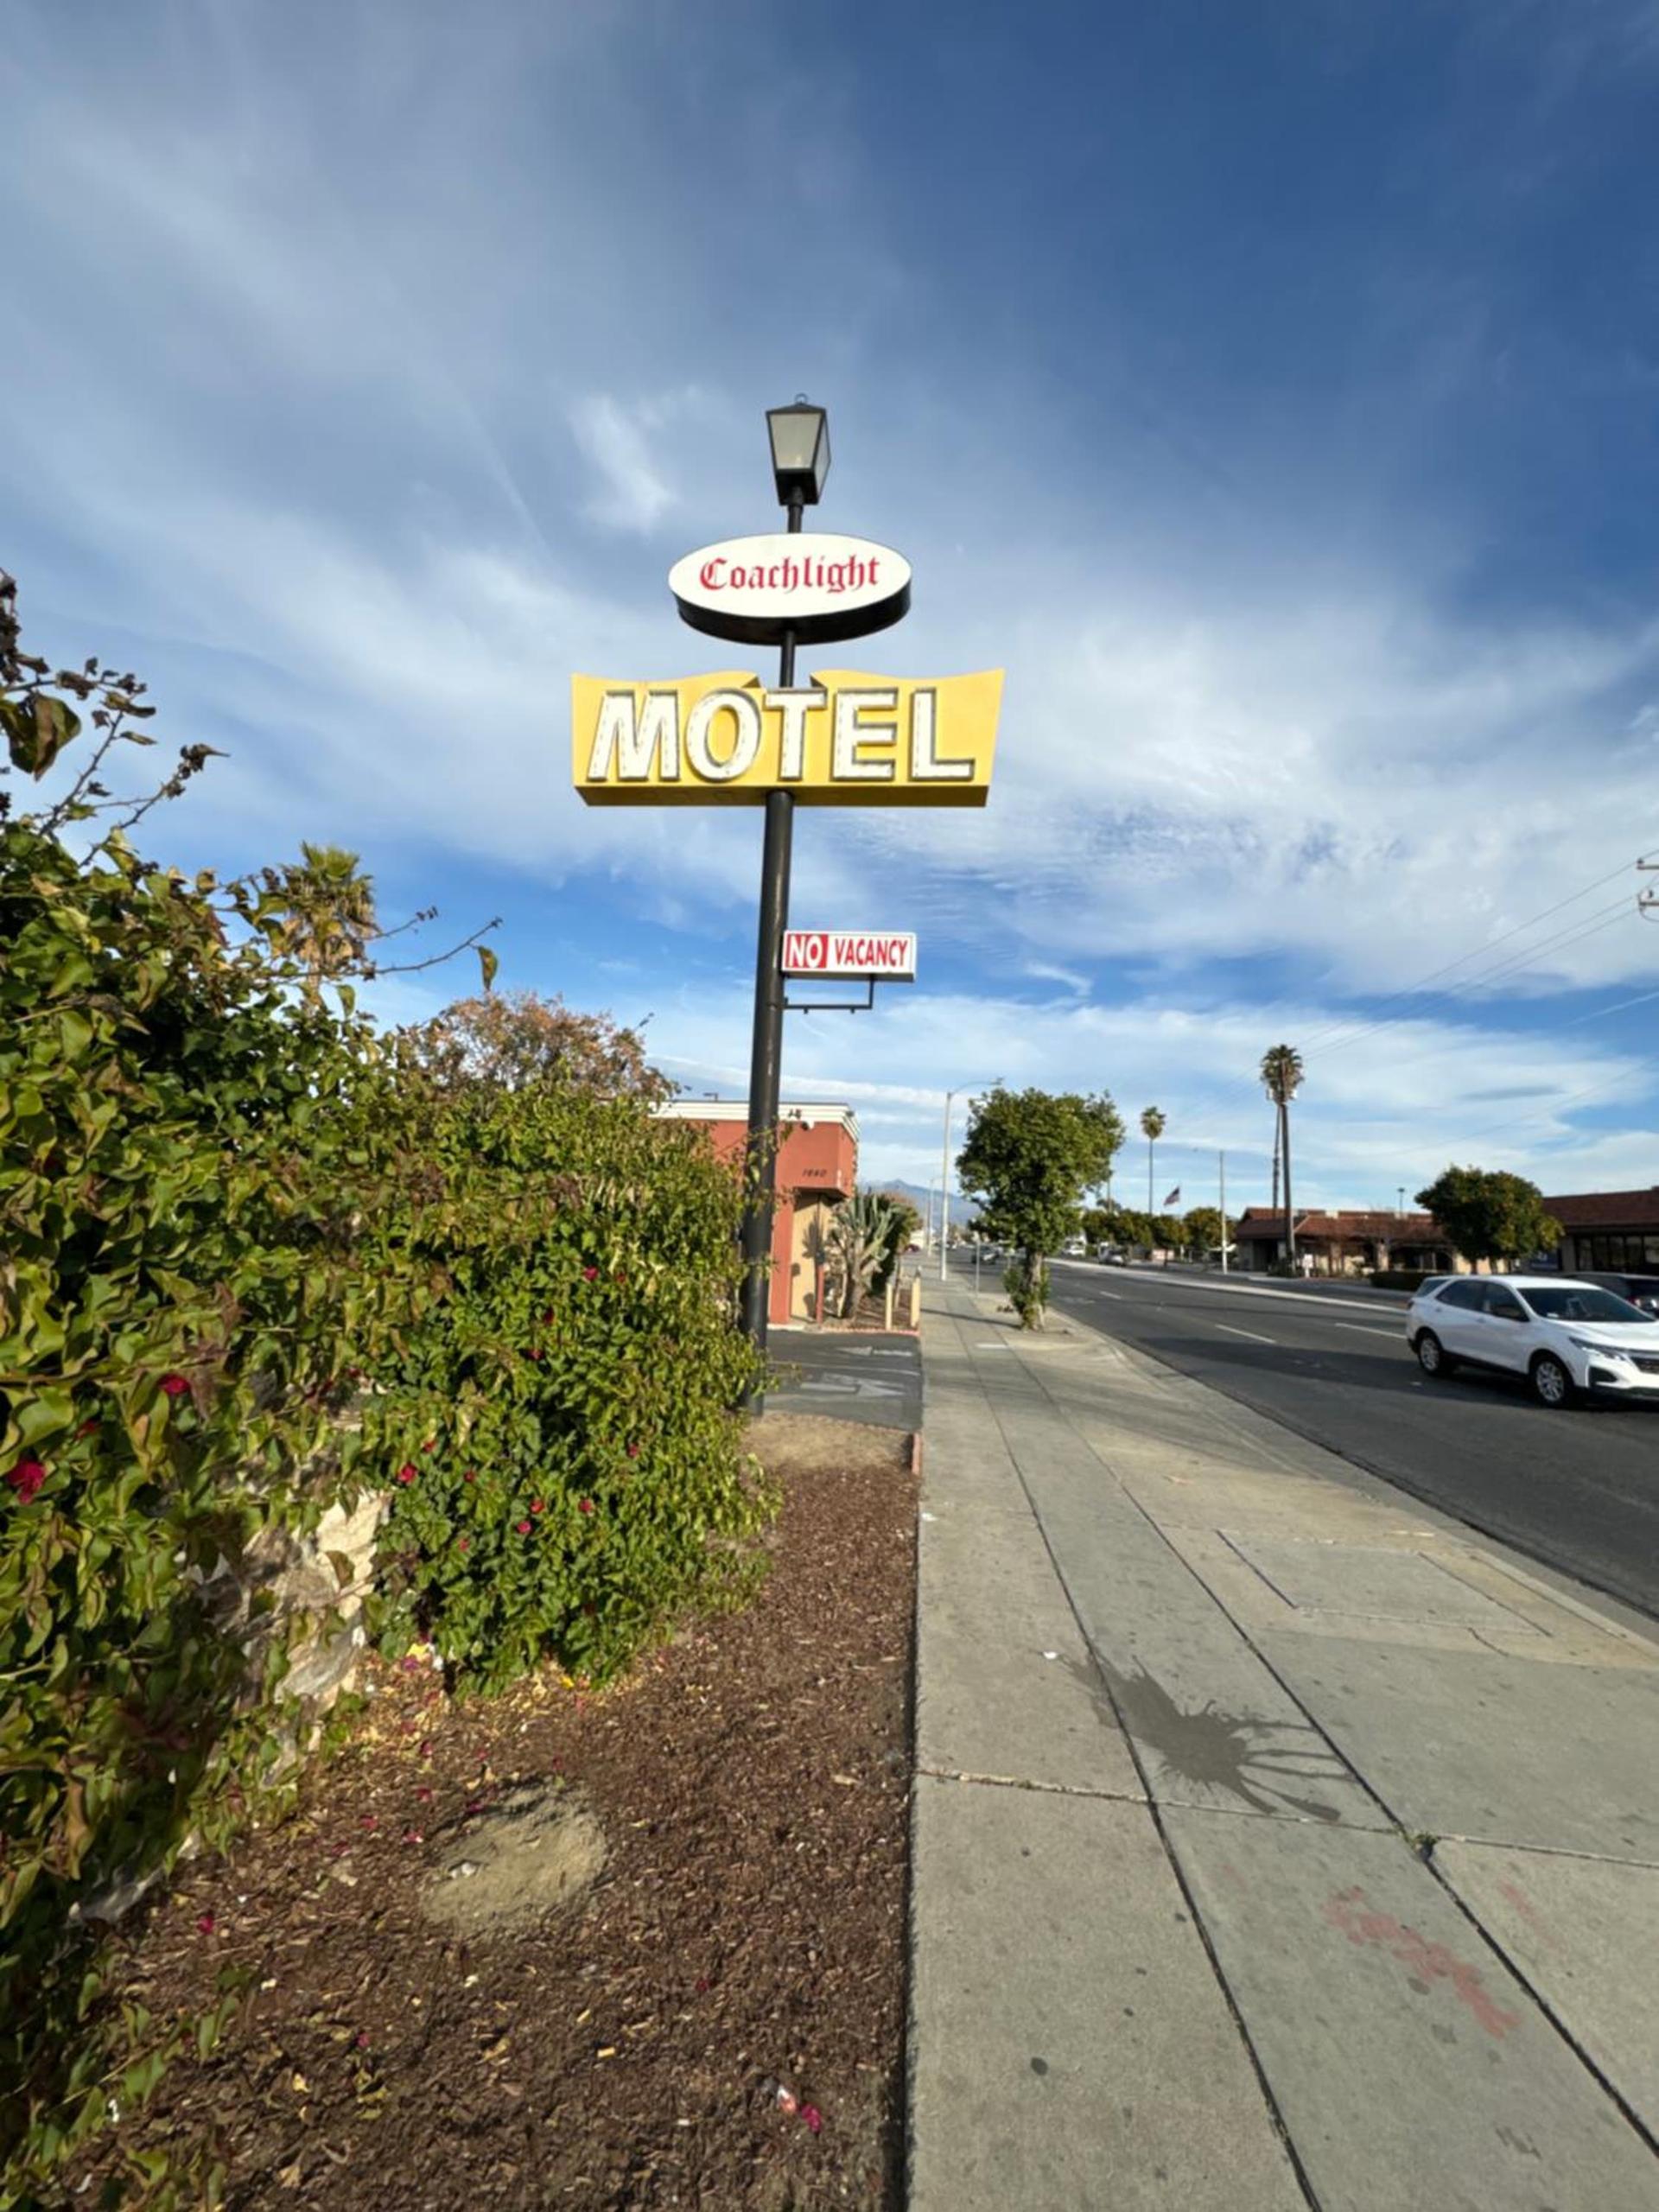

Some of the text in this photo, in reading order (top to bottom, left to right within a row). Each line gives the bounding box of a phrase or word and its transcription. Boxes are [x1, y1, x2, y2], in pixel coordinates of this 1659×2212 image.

[699, 554, 880, 594] Coachlight
[586, 687, 976, 783] MOTEL
[788, 934, 908, 969] NO VACANCY
